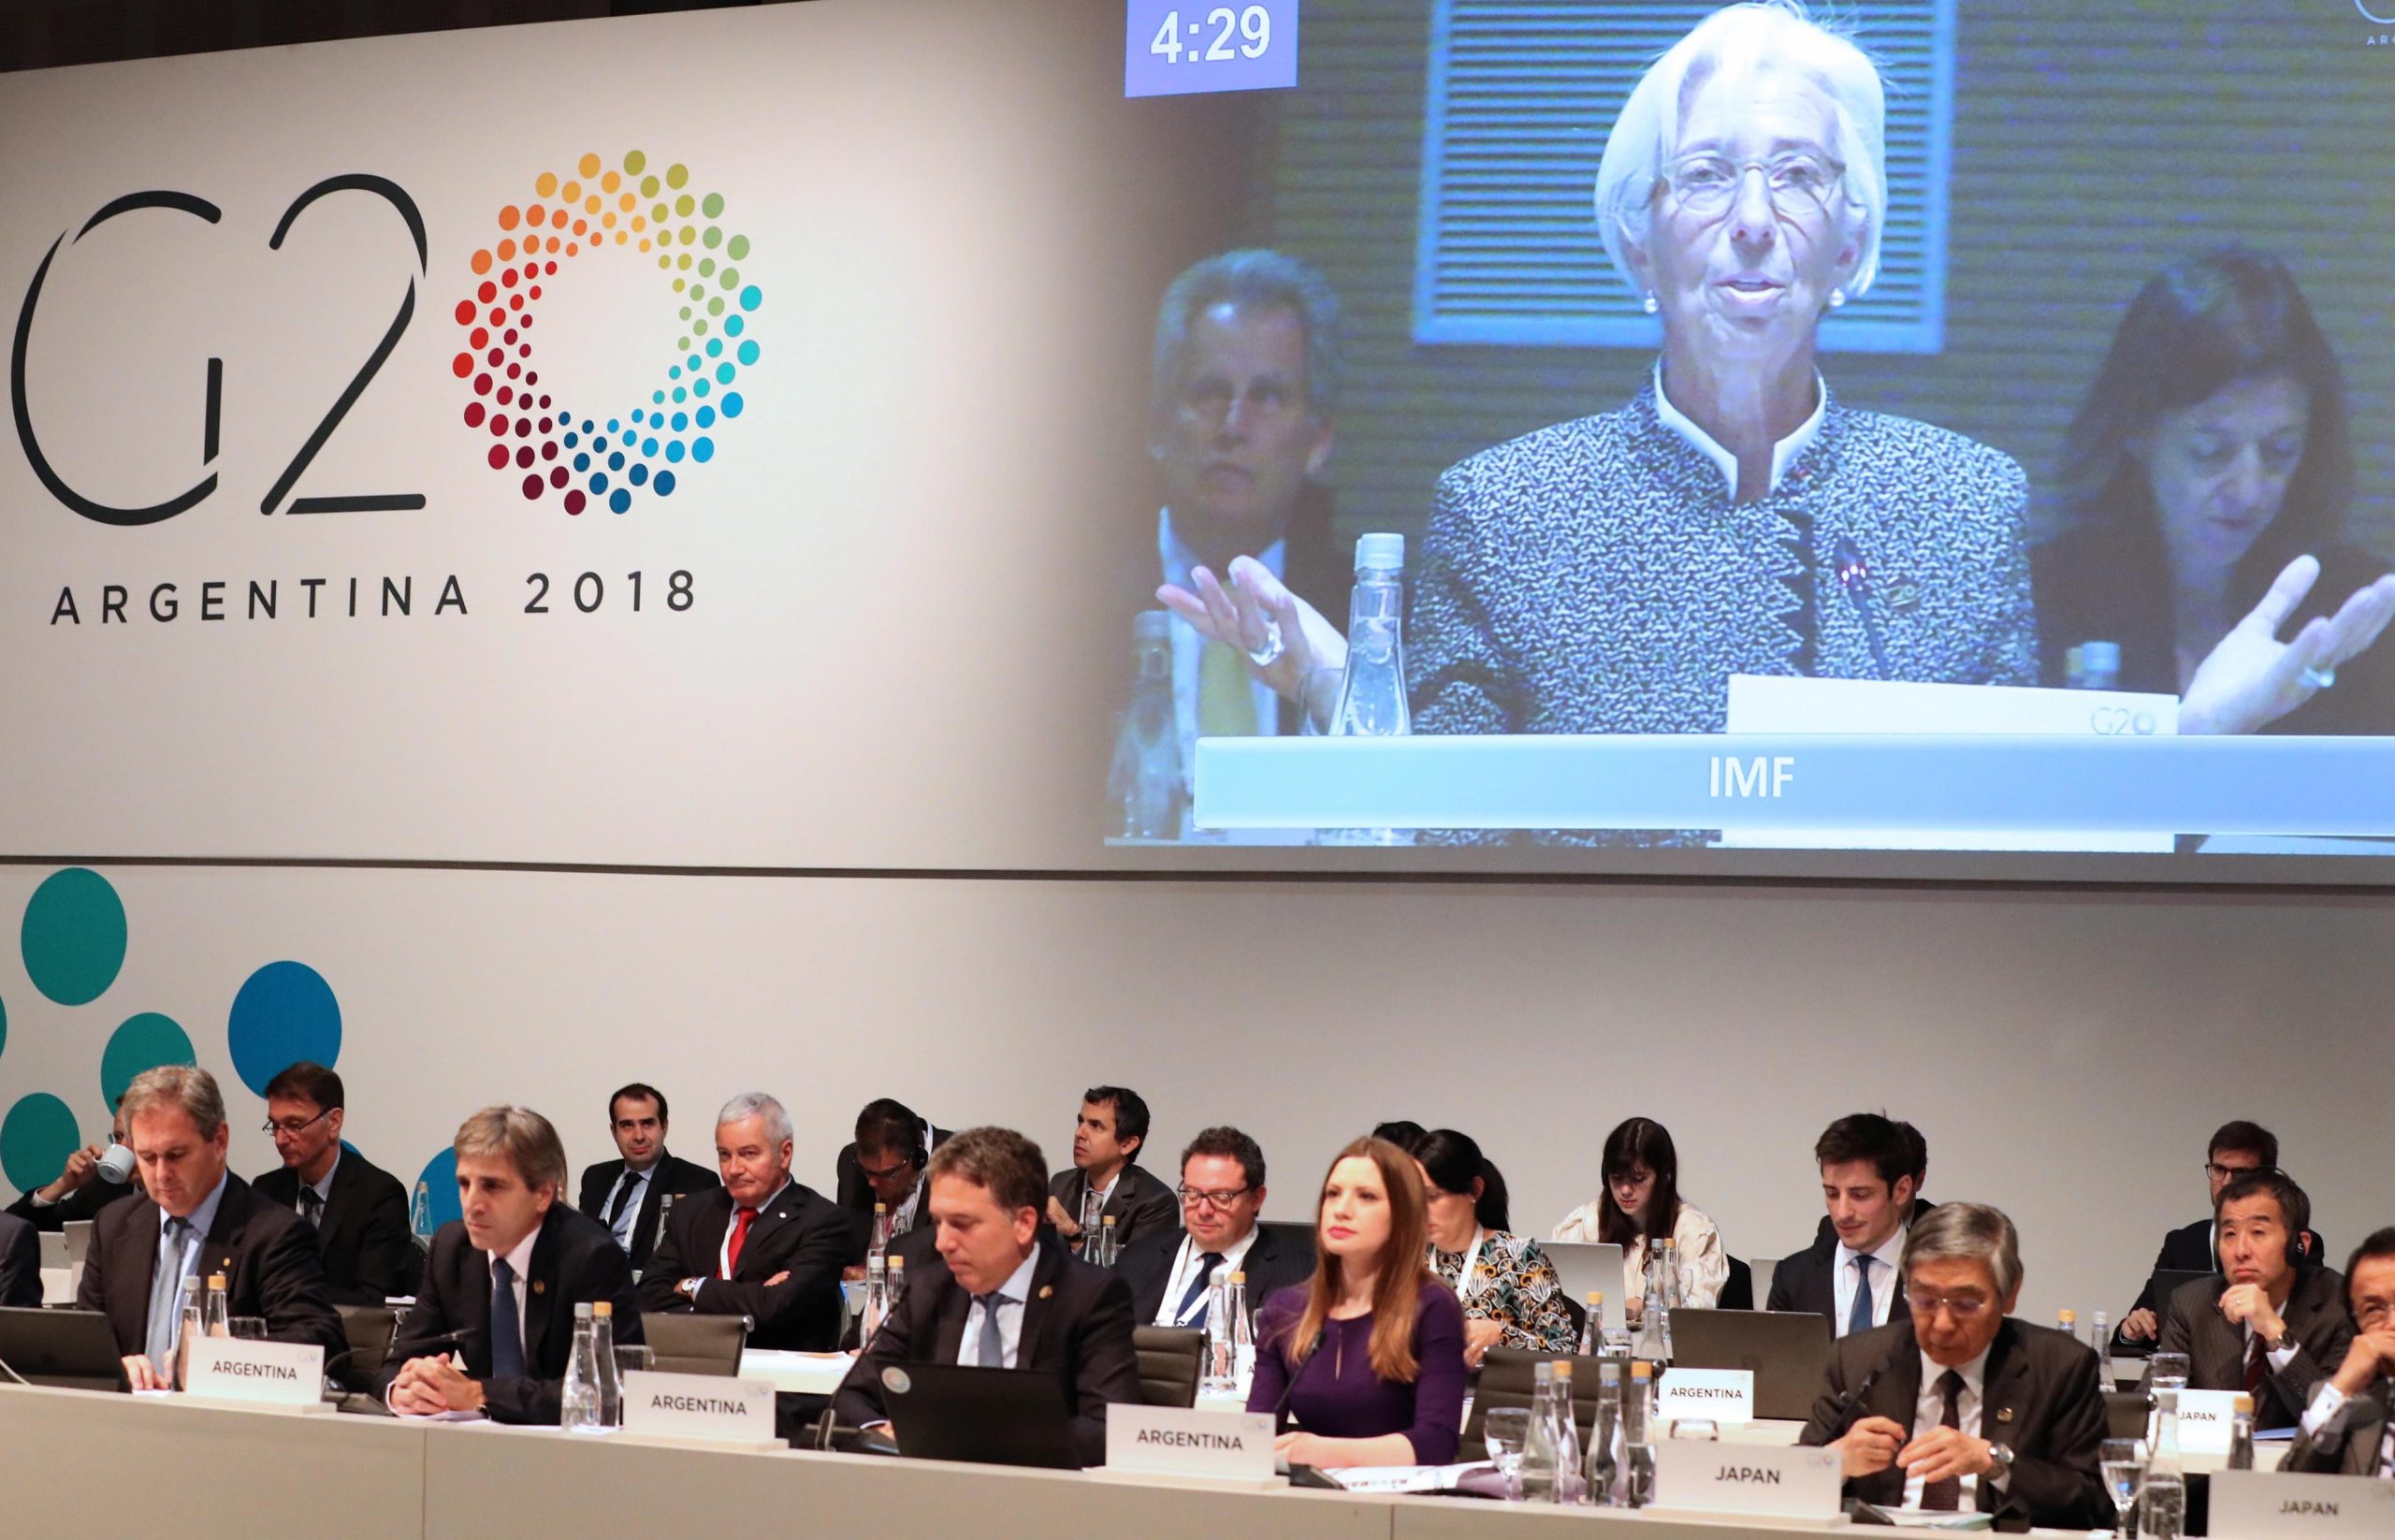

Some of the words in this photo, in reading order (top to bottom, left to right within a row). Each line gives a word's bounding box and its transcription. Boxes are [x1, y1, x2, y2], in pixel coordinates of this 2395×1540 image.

[1150, 5, 1270, 64] 4:29
[51, 574, 468, 625] ARGENTINA
[524, 570, 694, 614] 2018
[1709, 756, 1794, 797] IMF
[212, 1360, 298, 1380] ARGENTINA
[1670, 1387, 1743, 1399] ARGENTINA
[651, 1395, 748, 1416] ARGENTINA
[2179, 1412, 2216, 1421] JAPAN
[1137, 1429, 1243, 1450] ARGENTINA
[1715, 1466, 1780, 1485] JAPAN
[2279, 1500, 2339, 1516] JAPAN
